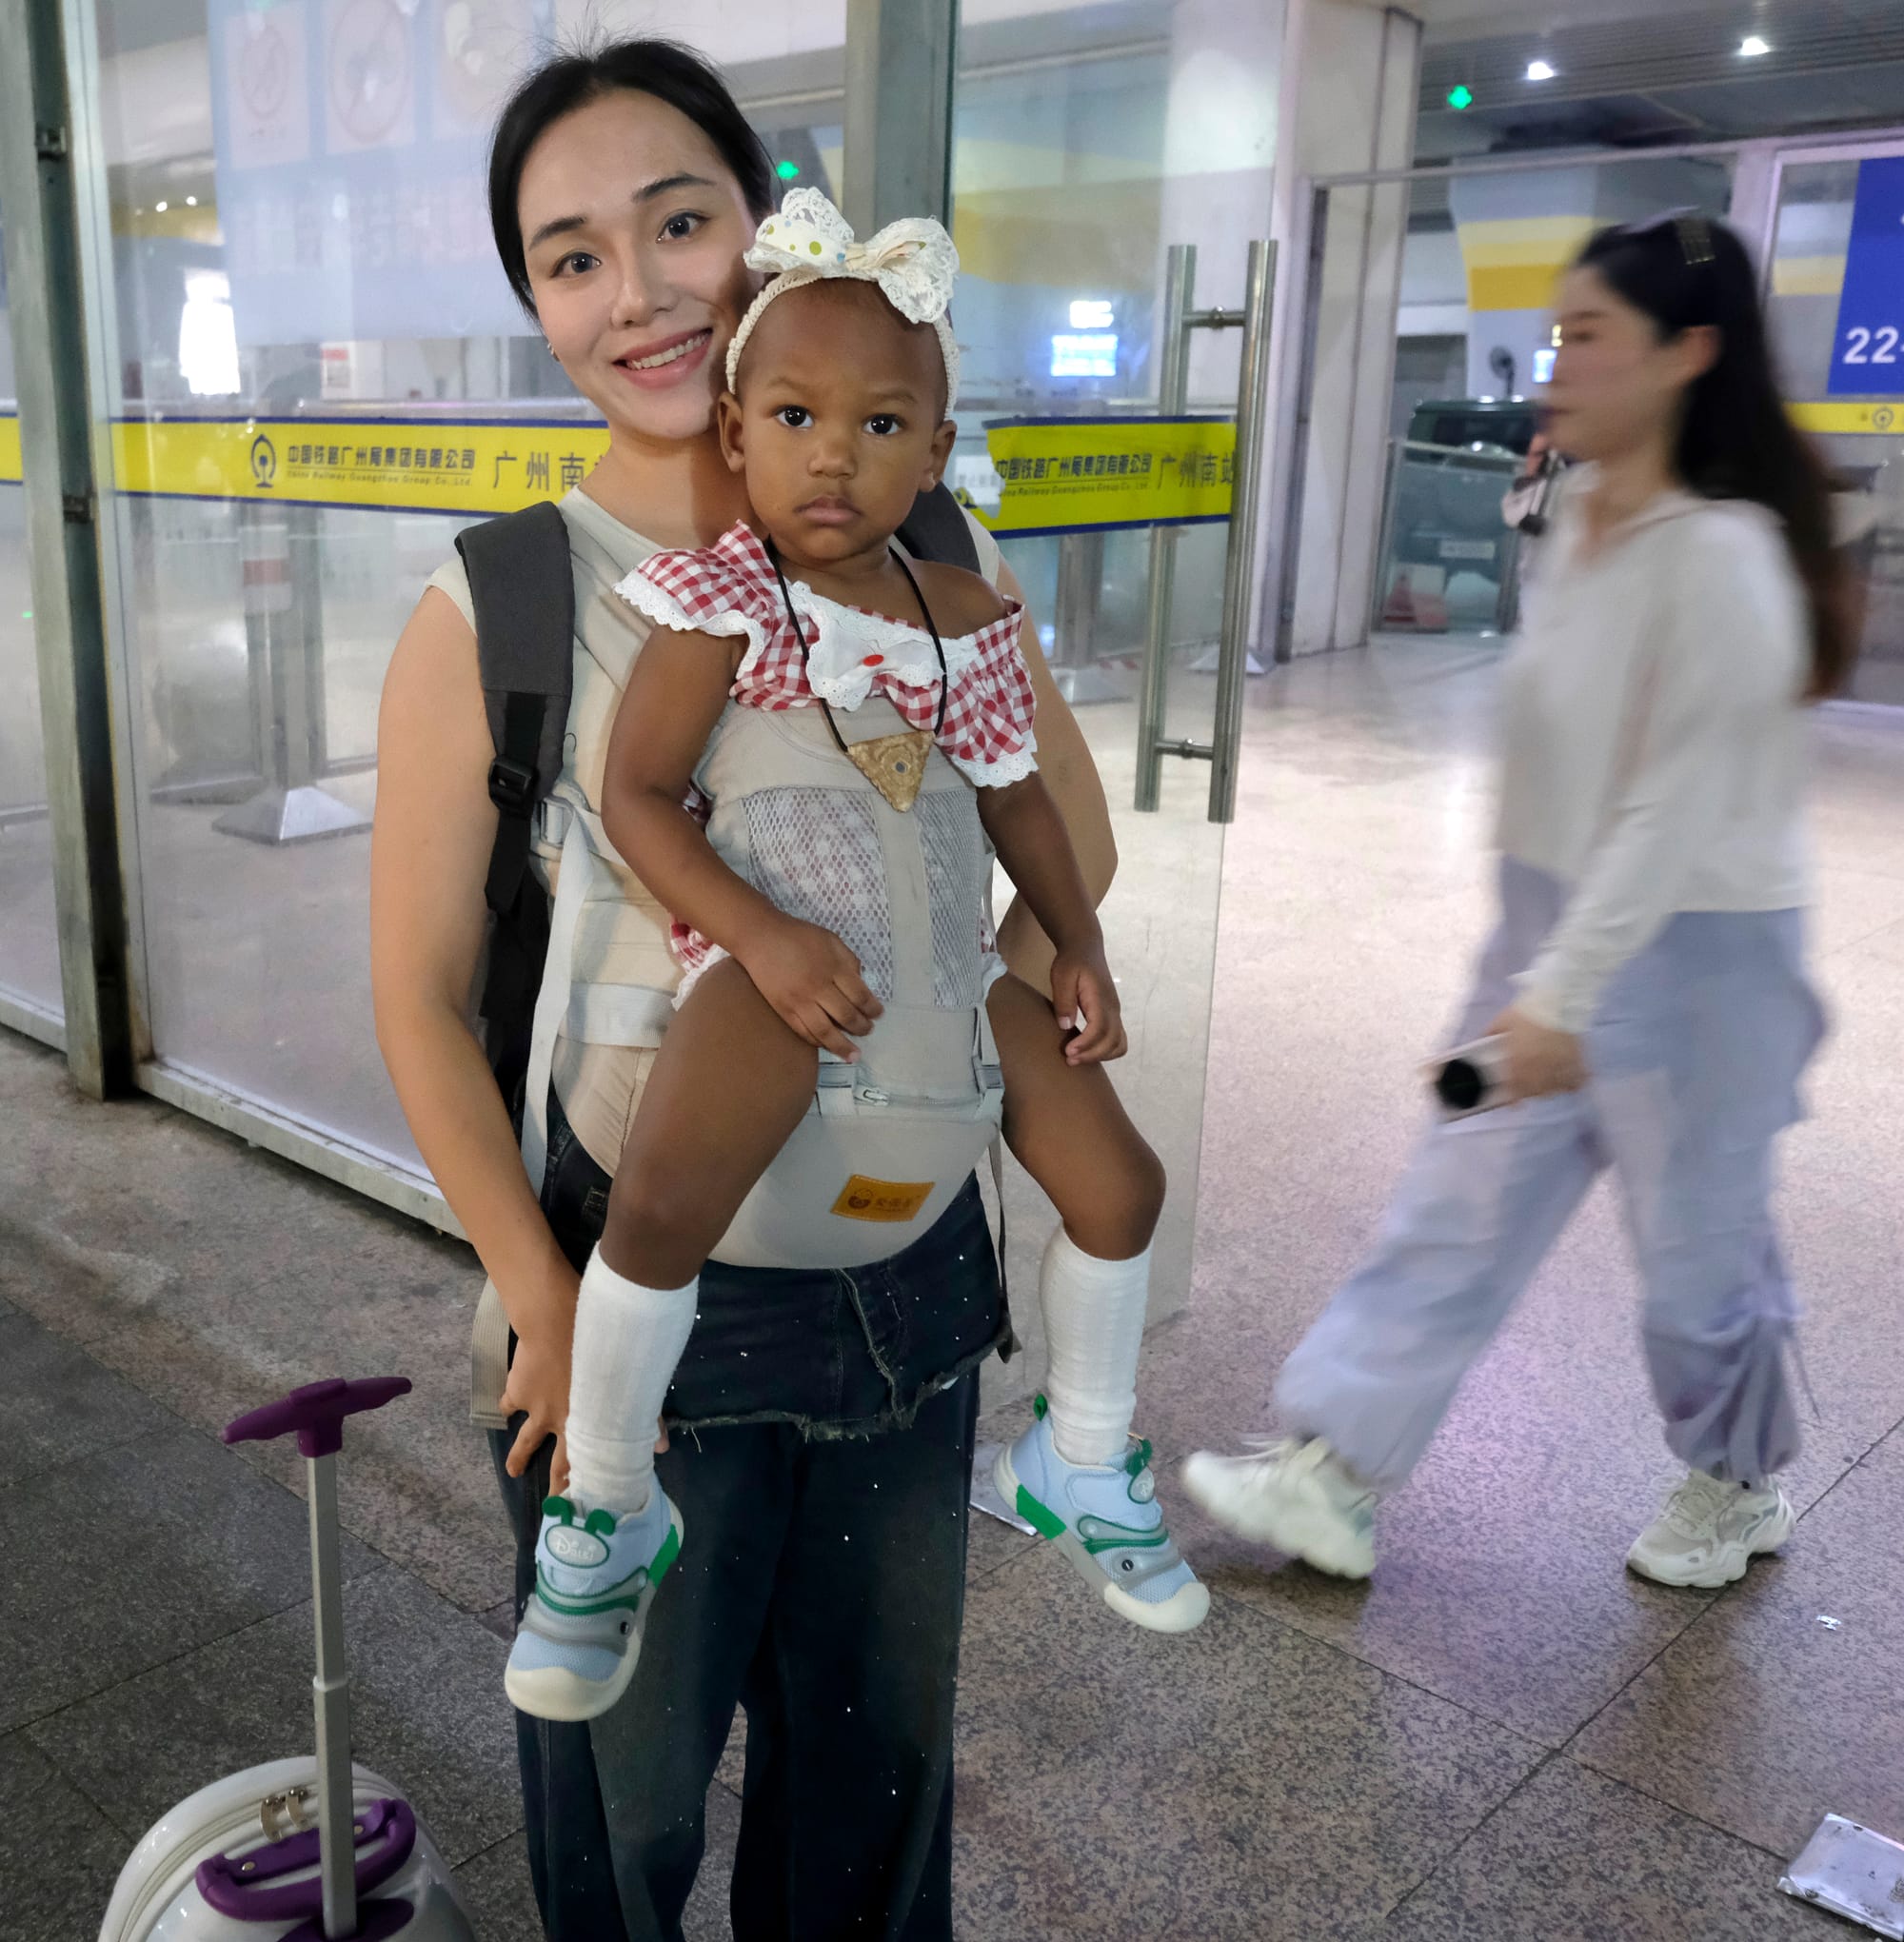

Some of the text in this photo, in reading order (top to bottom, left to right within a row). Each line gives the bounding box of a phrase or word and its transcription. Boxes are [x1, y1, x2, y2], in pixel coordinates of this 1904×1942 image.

[1842, 326, 1904, 364] 22
[288, 445, 475, 469] 中国铁路广州局集团有限公司
[493, 450, 602, 492] 广州南
[403, 474, 429, 485] Group
